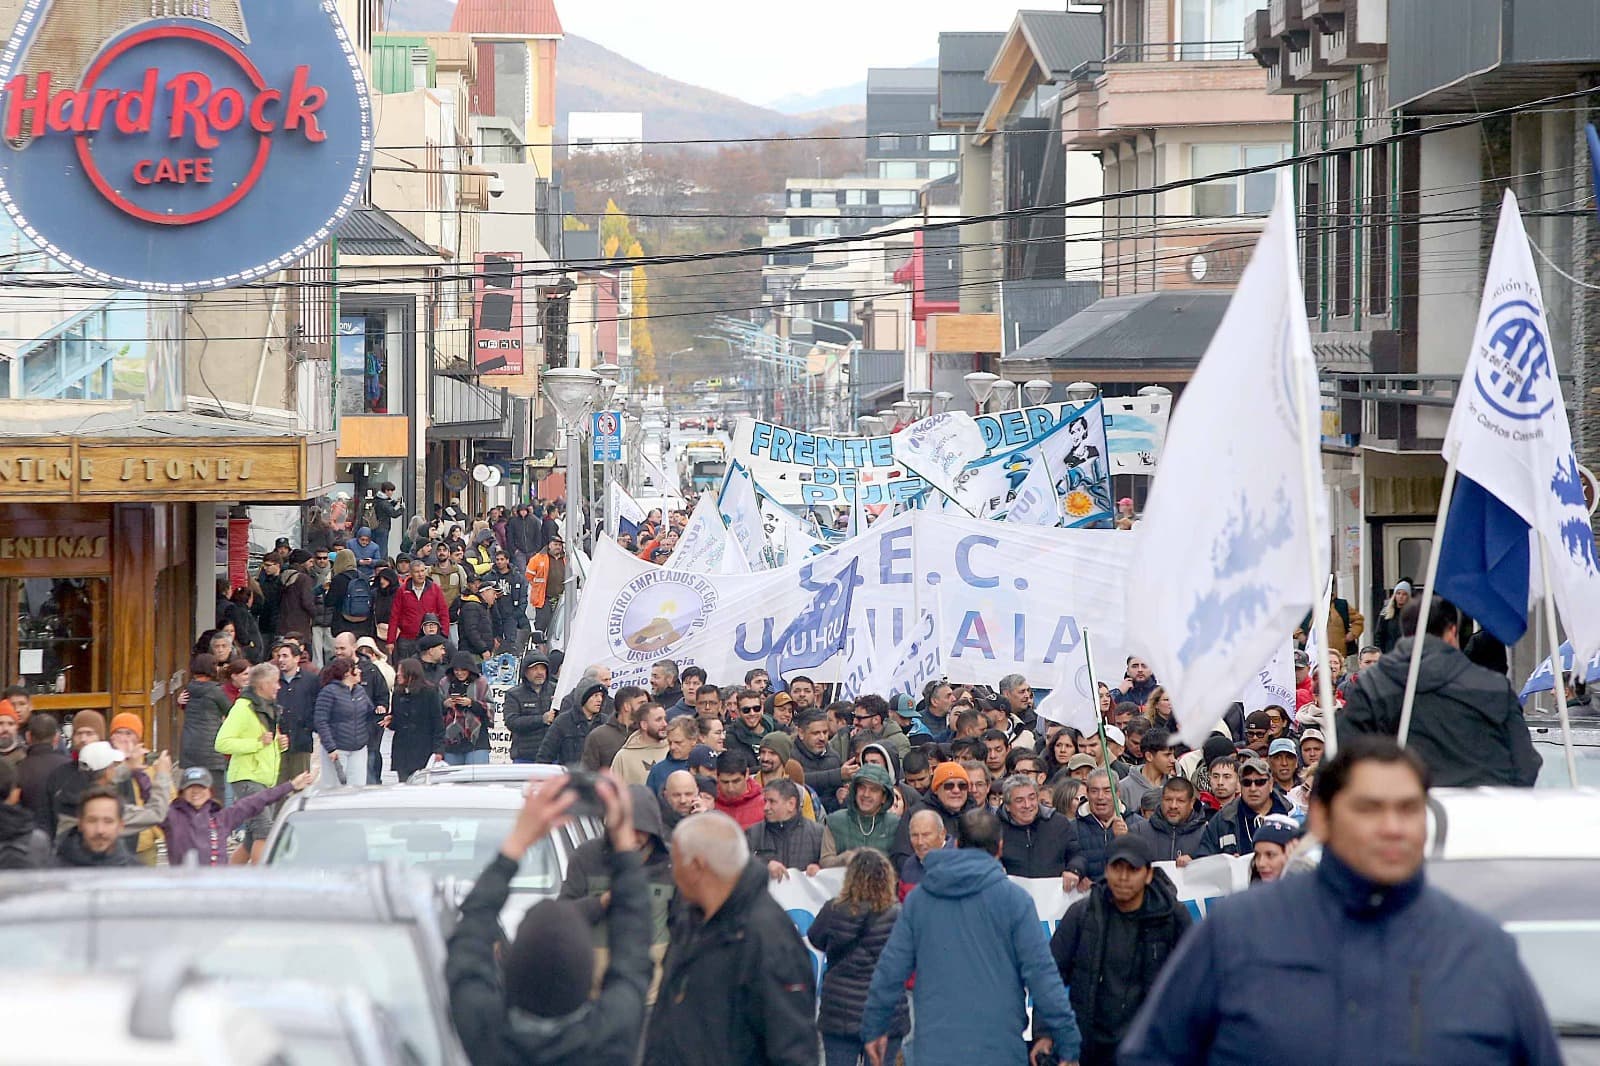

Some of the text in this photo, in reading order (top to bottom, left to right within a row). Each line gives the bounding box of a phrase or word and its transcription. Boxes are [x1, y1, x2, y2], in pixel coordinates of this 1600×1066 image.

[5, 64, 328, 149] Hard Rock
[132, 157, 214, 185] CAFE
[751, 421, 894, 467] FRENTE
[120, 457, 255, 481] STONES
[610, 590, 632, 635] CENTRO
[630, 570, 697, 594] EMPLEADOS
